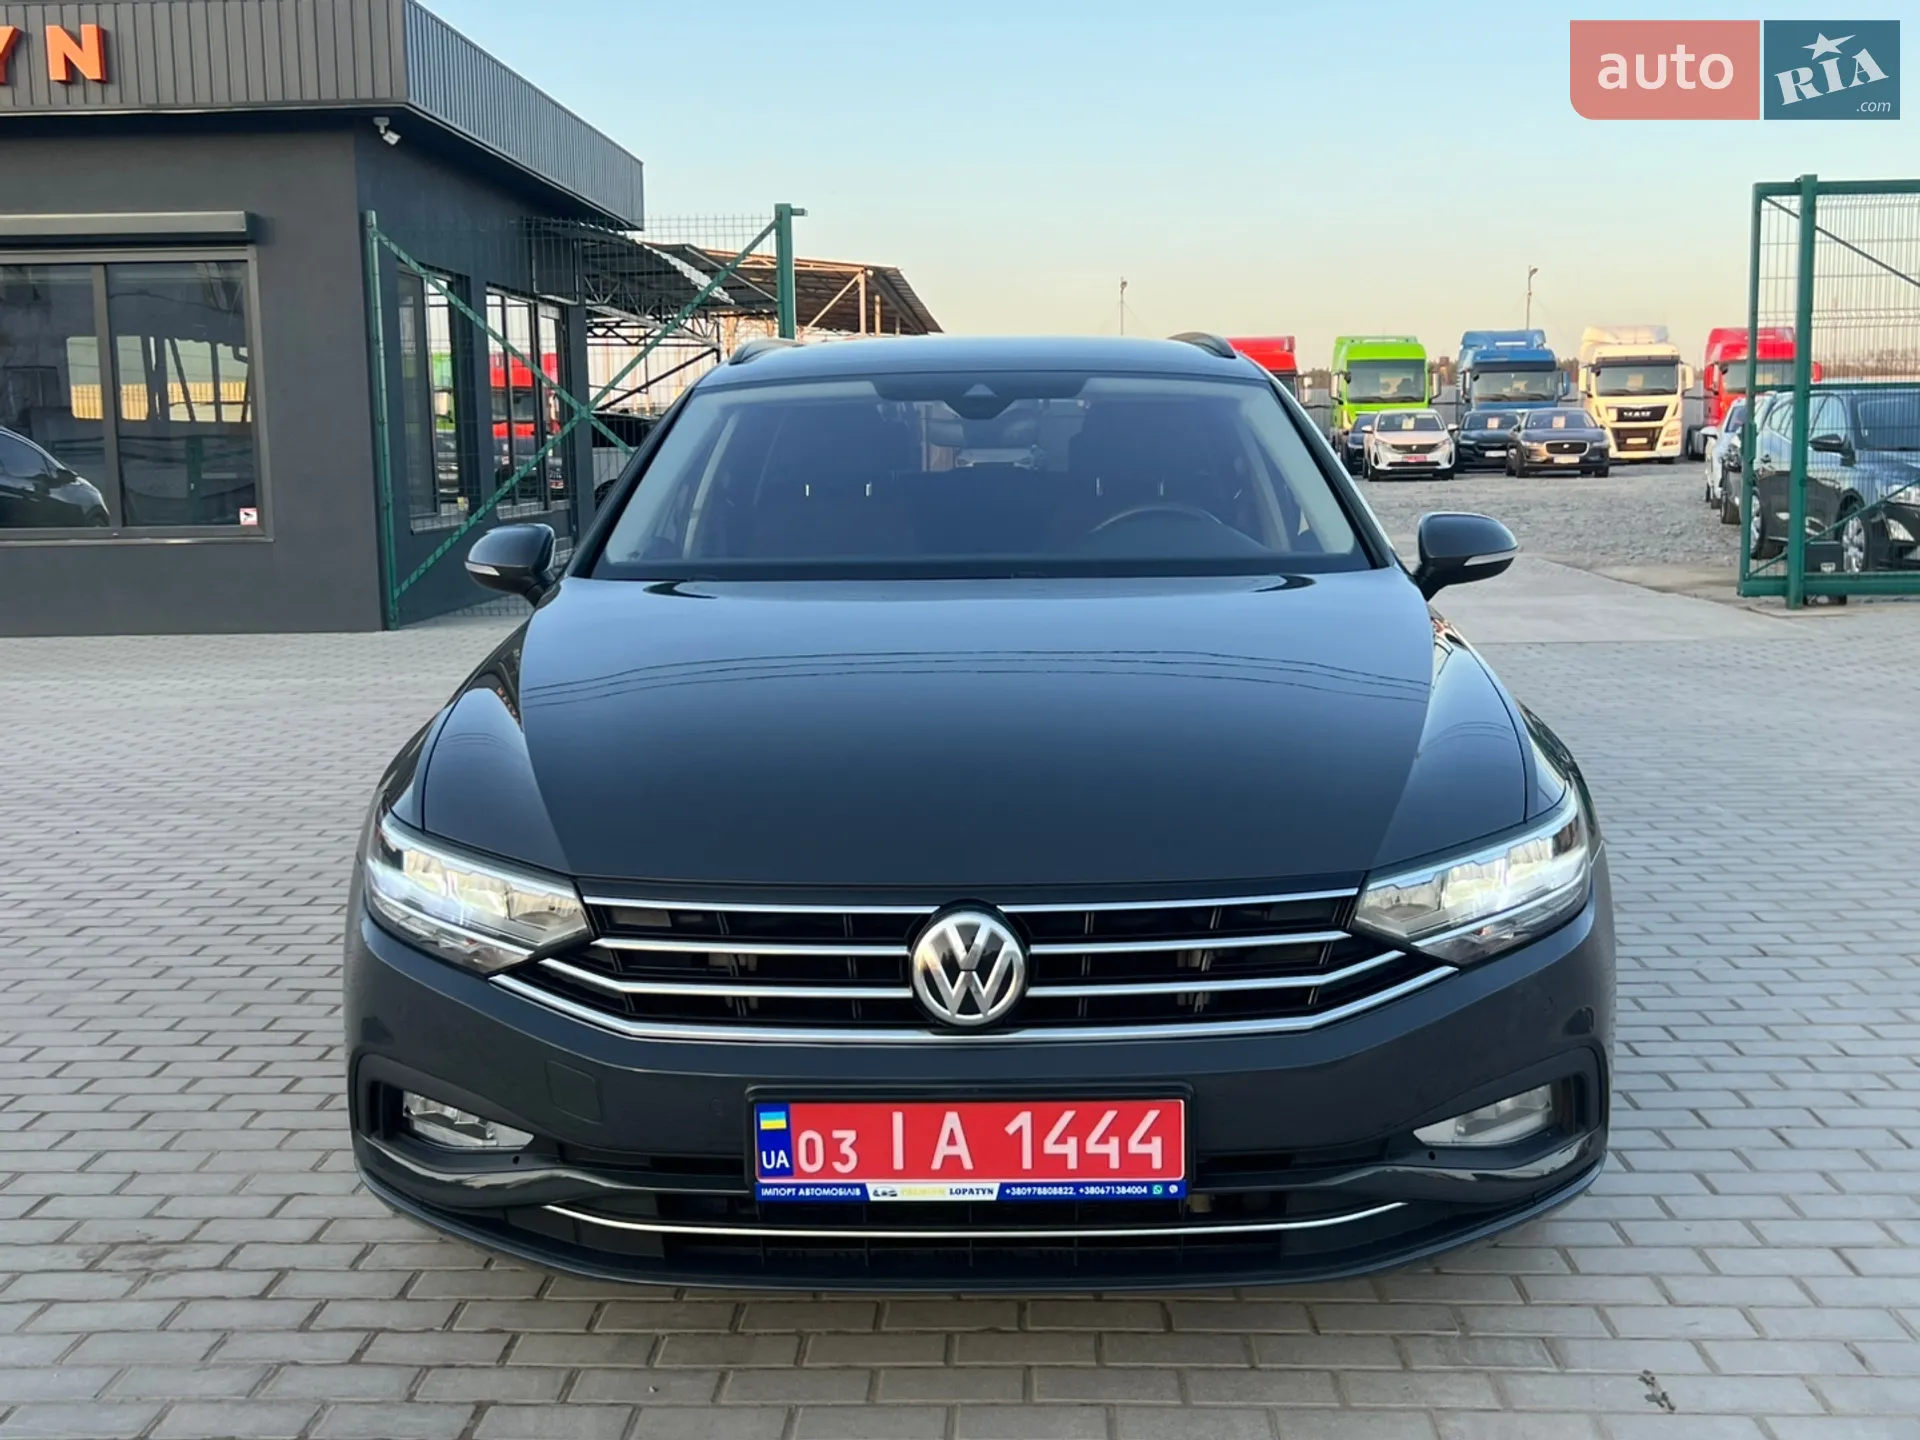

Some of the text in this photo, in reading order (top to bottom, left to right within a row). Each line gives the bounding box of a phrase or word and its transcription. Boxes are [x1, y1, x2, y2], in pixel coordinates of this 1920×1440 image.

[798, 1130, 859, 1174] 03
[1004, 1109, 1163, 1170] 1444
[762, 1150, 790, 1169] UA
[761, 1187, 861, 1197] ІМПОРТ АВТОМОБІЛІВ
[949, 1187, 995, 1196] LOPATYN
